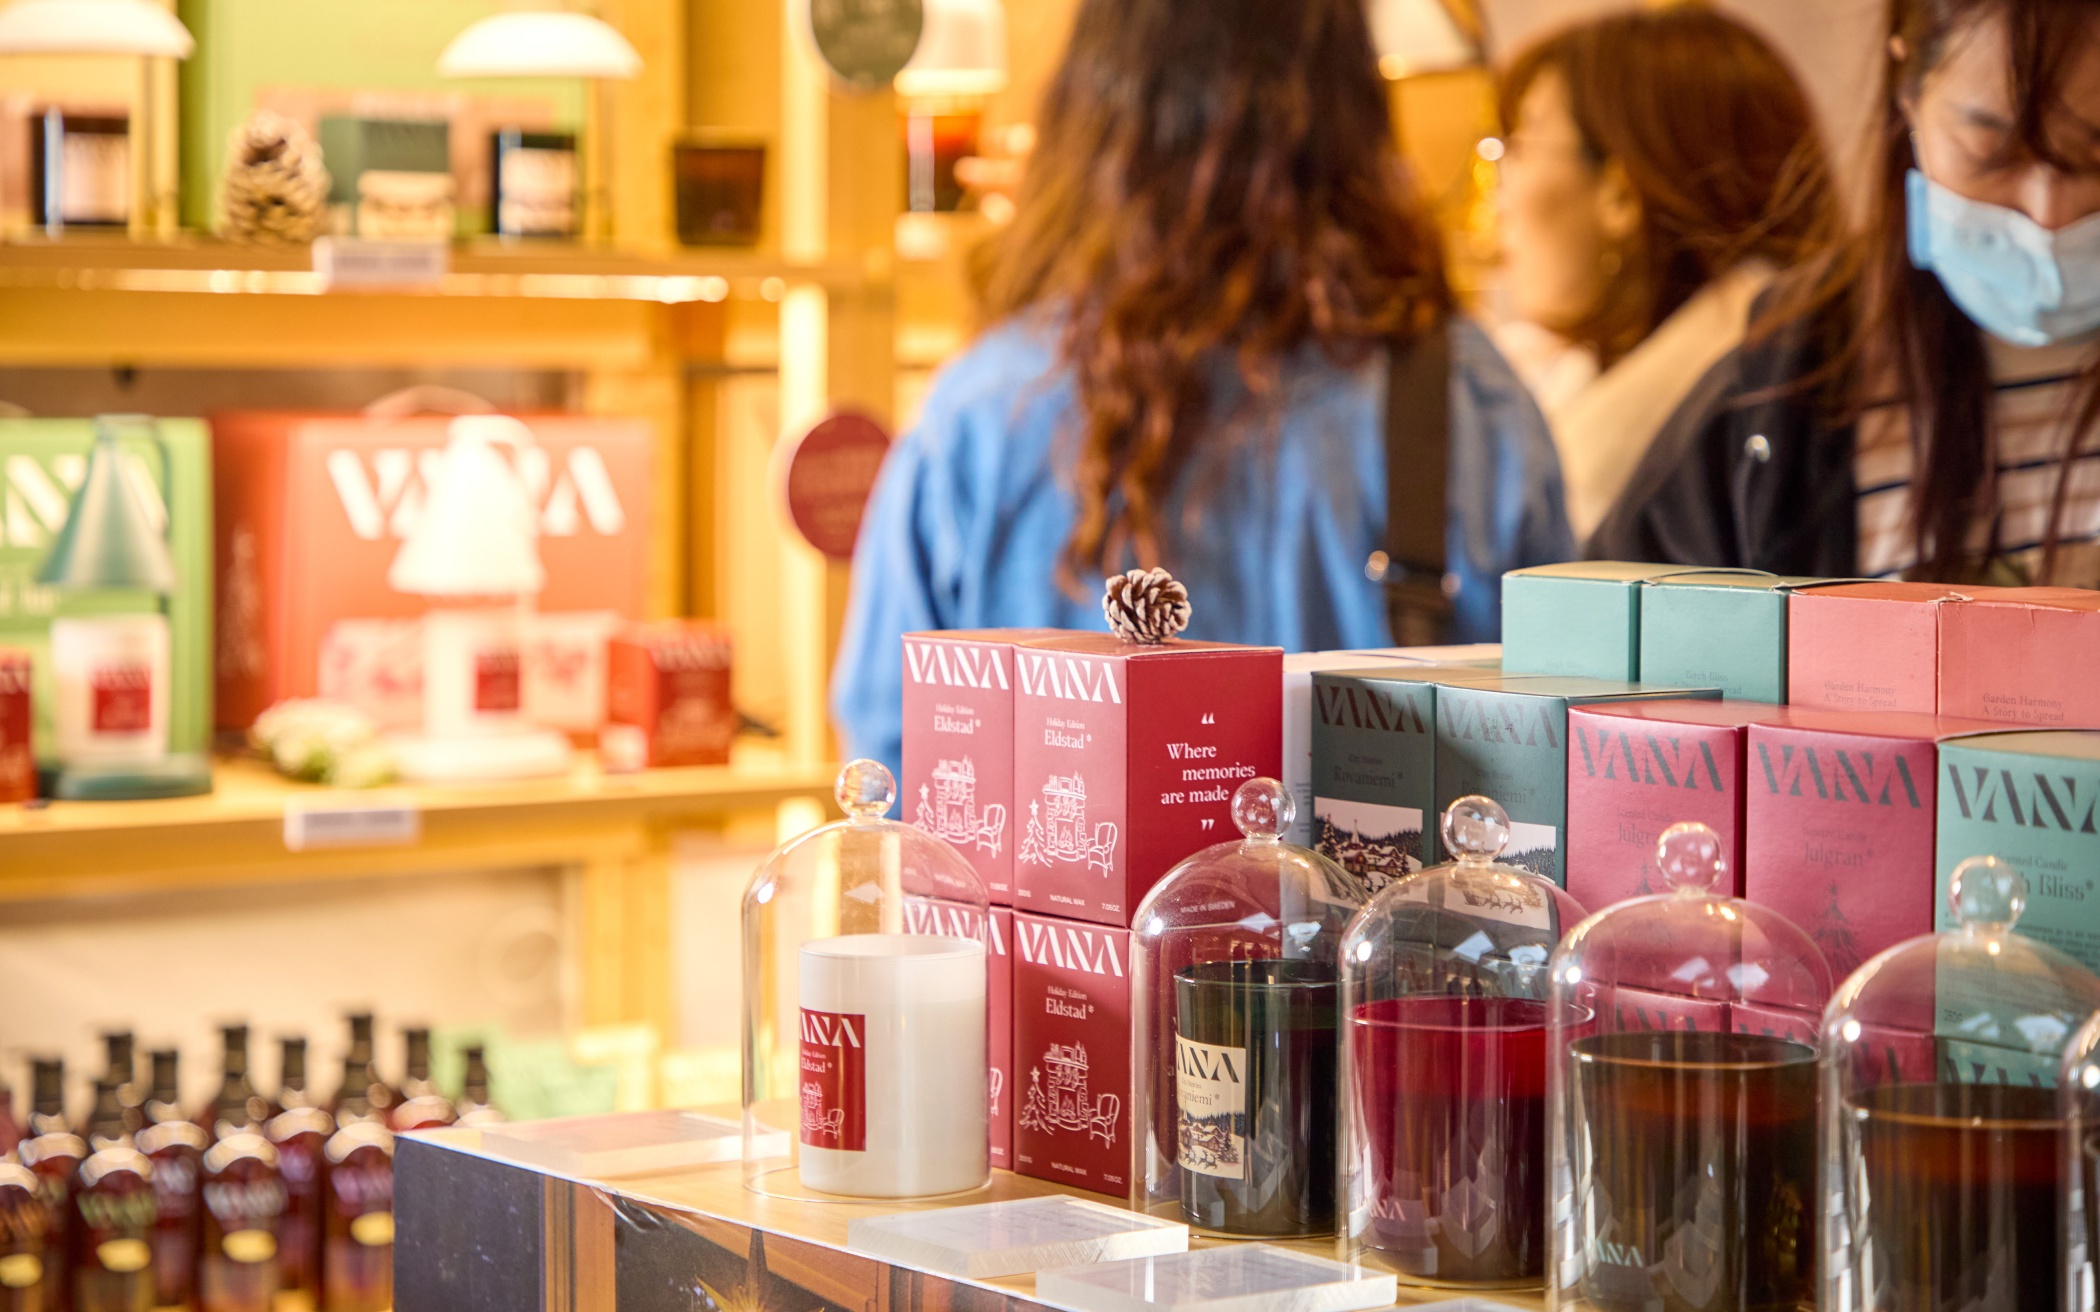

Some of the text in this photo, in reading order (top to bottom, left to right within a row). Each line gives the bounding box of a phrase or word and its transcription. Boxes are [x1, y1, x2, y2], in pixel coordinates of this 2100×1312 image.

[326, 446, 626, 540] VAA
[905, 642, 1009, 690] VANA
[1686, 670, 1706, 680] Birch
[1017, 654, 1121, 704] VANA
[1824, 680, 1896, 697] Garden Harmony
[1315, 684, 1425, 734] VANA
[1833, 693, 1855, 706] Story
[1858, 696, 1867, 705] to
[1870, 696, 1897, 708] Spread
[1983, 692, 2064, 711] Garden Harmony
[1046, 717, 1086, 730] Holiday Edition
[1441, 696, 1559, 748] VANA
[1983, 705, 2064, 722] A Story to Spread
[934, 715, 974, 734] Eldstad
[1045, 729, 1085, 749] Eldstad
[1166, 742, 1217, 759] Where
[1576, 727, 1724, 792] VANA
[1182, 762, 1256, 781] memories
[1333, 766, 1396, 788] Rovaniemi
[1757, 742, 1921, 809] VANA
[1161, 785, 1229, 805] are made
[1461, 780, 1527, 804] Rovaniemi
[1805, 843, 1864, 868] Julgran
[2035, 858, 2069, 871] Candle
[2040, 873, 2085, 901] Bliss
[1049, 894, 1073, 905] NATURAL
[1181, 901, 1236, 914] MADE IN SWEDEN
[1016, 921, 1124, 977] VANA
[1047, 986, 1088, 1000] Holiday Edition
[1045, 997, 1086, 1020] Eldstad
[1177, 1042, 1240, 1084] ANA
[1051, 1162, 1074, 1173] NATURAL
